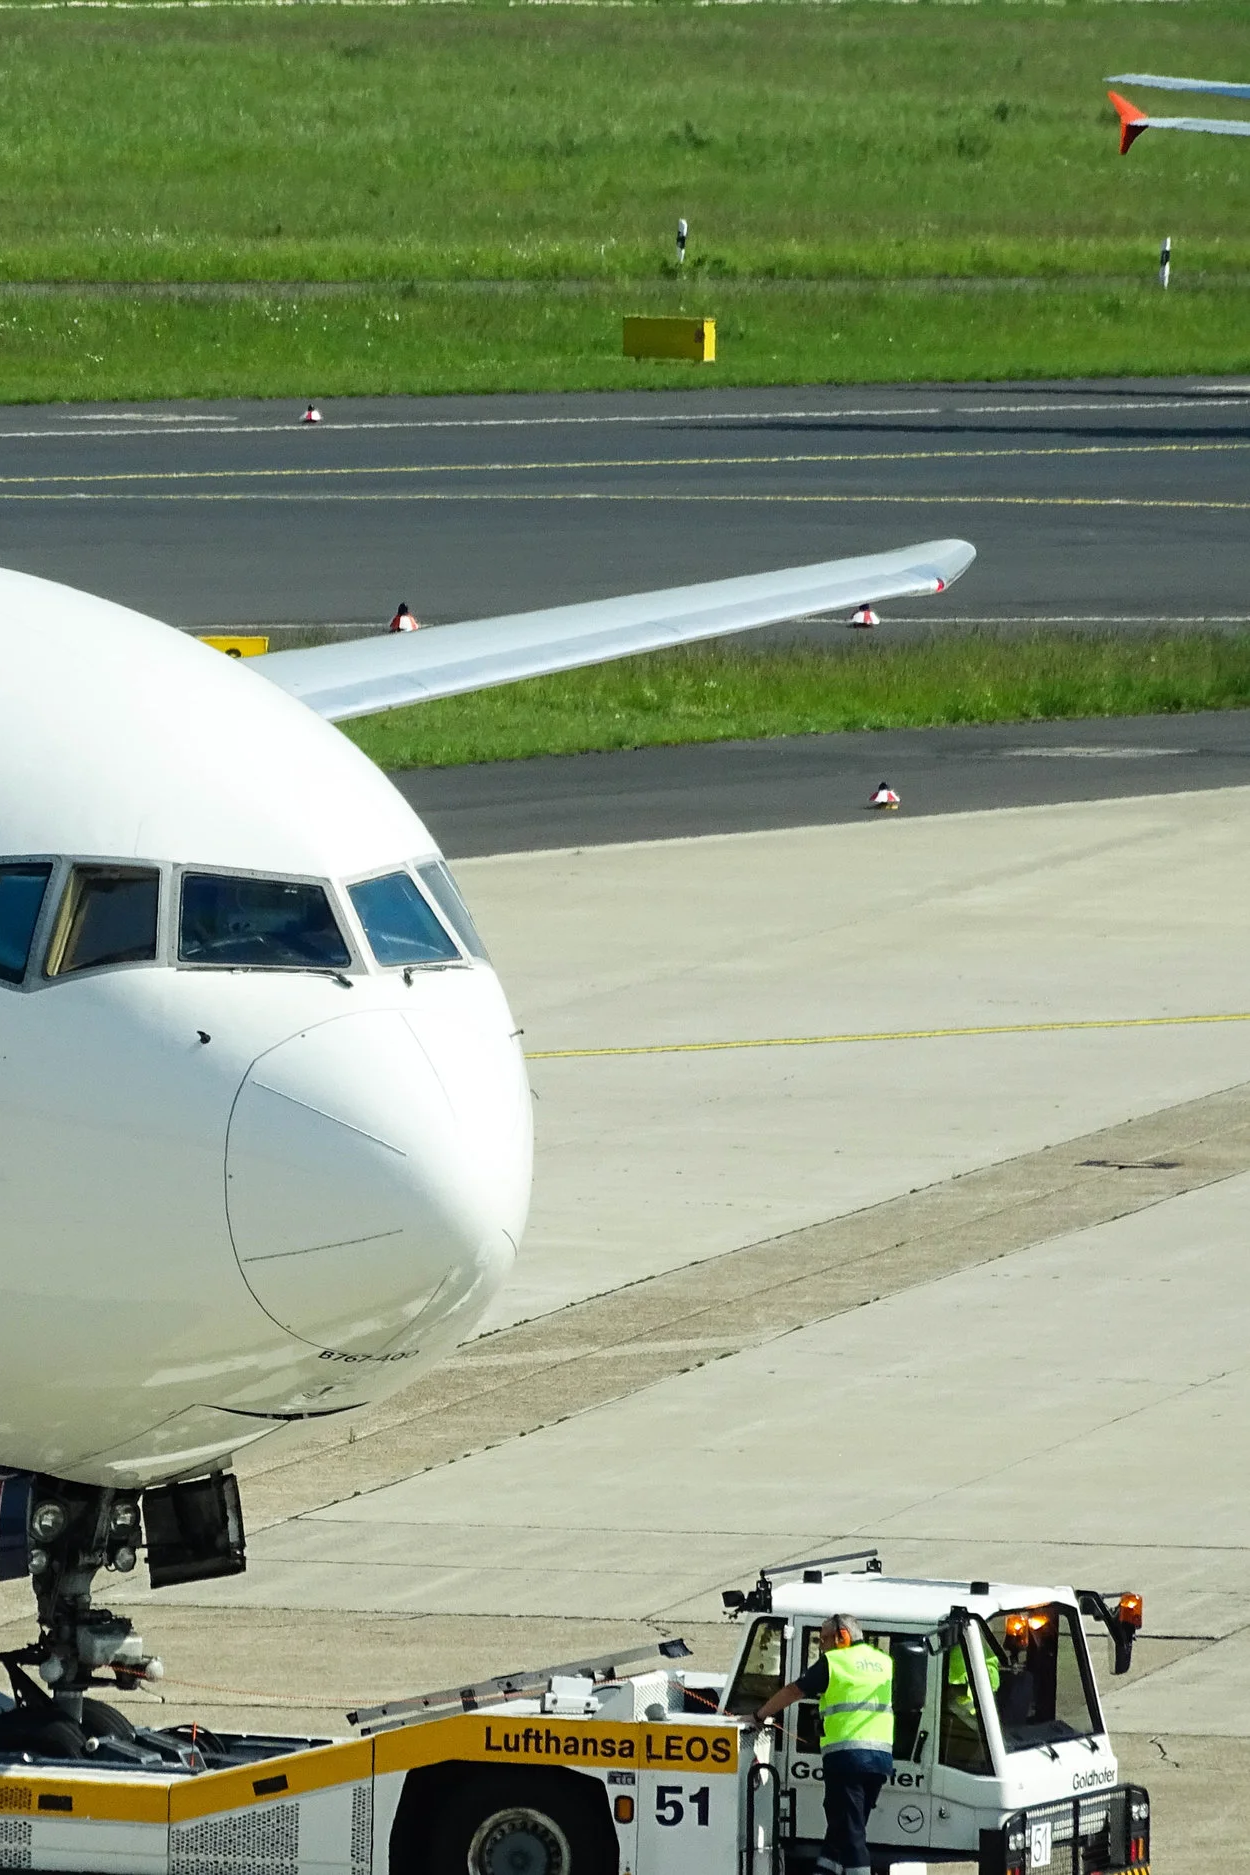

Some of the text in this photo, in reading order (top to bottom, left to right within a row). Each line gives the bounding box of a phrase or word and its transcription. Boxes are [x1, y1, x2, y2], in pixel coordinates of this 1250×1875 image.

[318, 1350, 419, 1363] B767-400
[485, 1726, 732, 1764] Lufthansa LEOS
[791, 1761, 925, 1788] Gofer
[1072, 1767, 1116, 1791] Goldhofer
[655, 1786, 710, 1827] 51
[1033, 1825, 1048, 1863] 51
